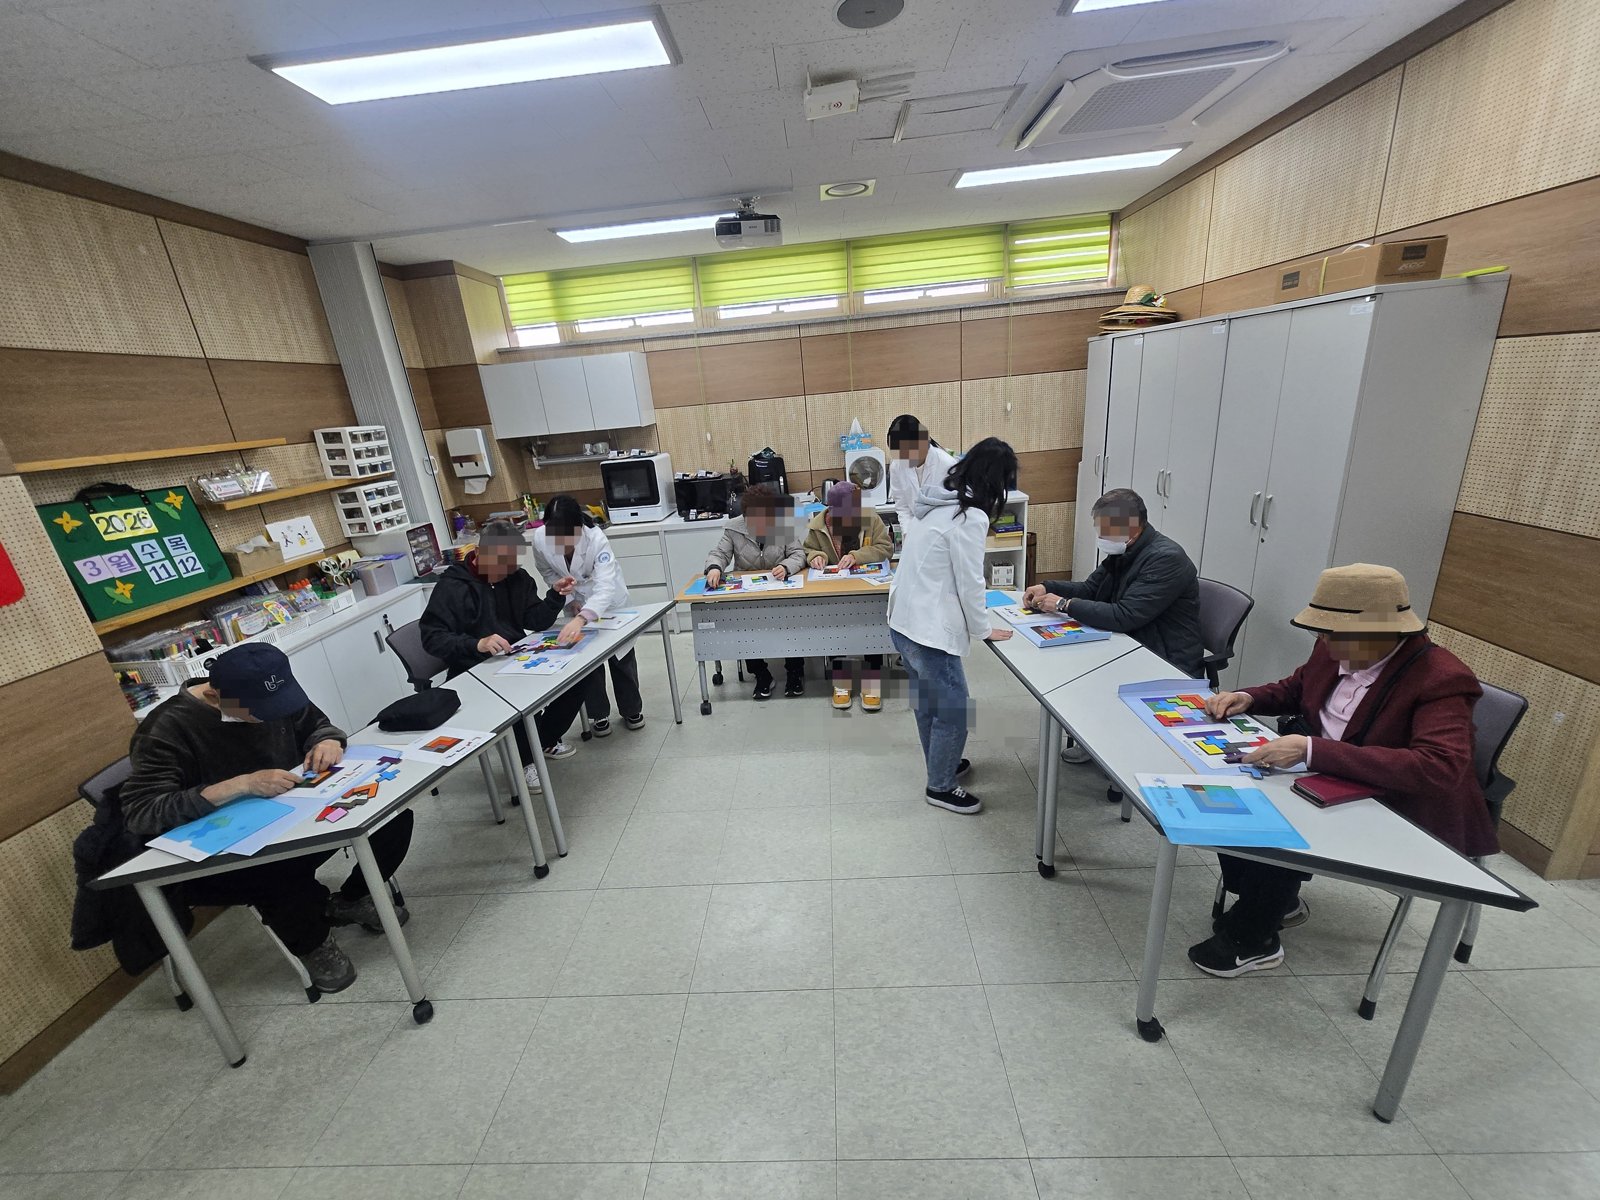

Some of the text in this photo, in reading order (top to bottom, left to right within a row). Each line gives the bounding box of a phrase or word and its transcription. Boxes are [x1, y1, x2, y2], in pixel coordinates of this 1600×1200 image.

[95, 511, 153, 536] 2026
[141, 536, 188, 559] 수 목
[149, 556, 202, 583] 11 12
